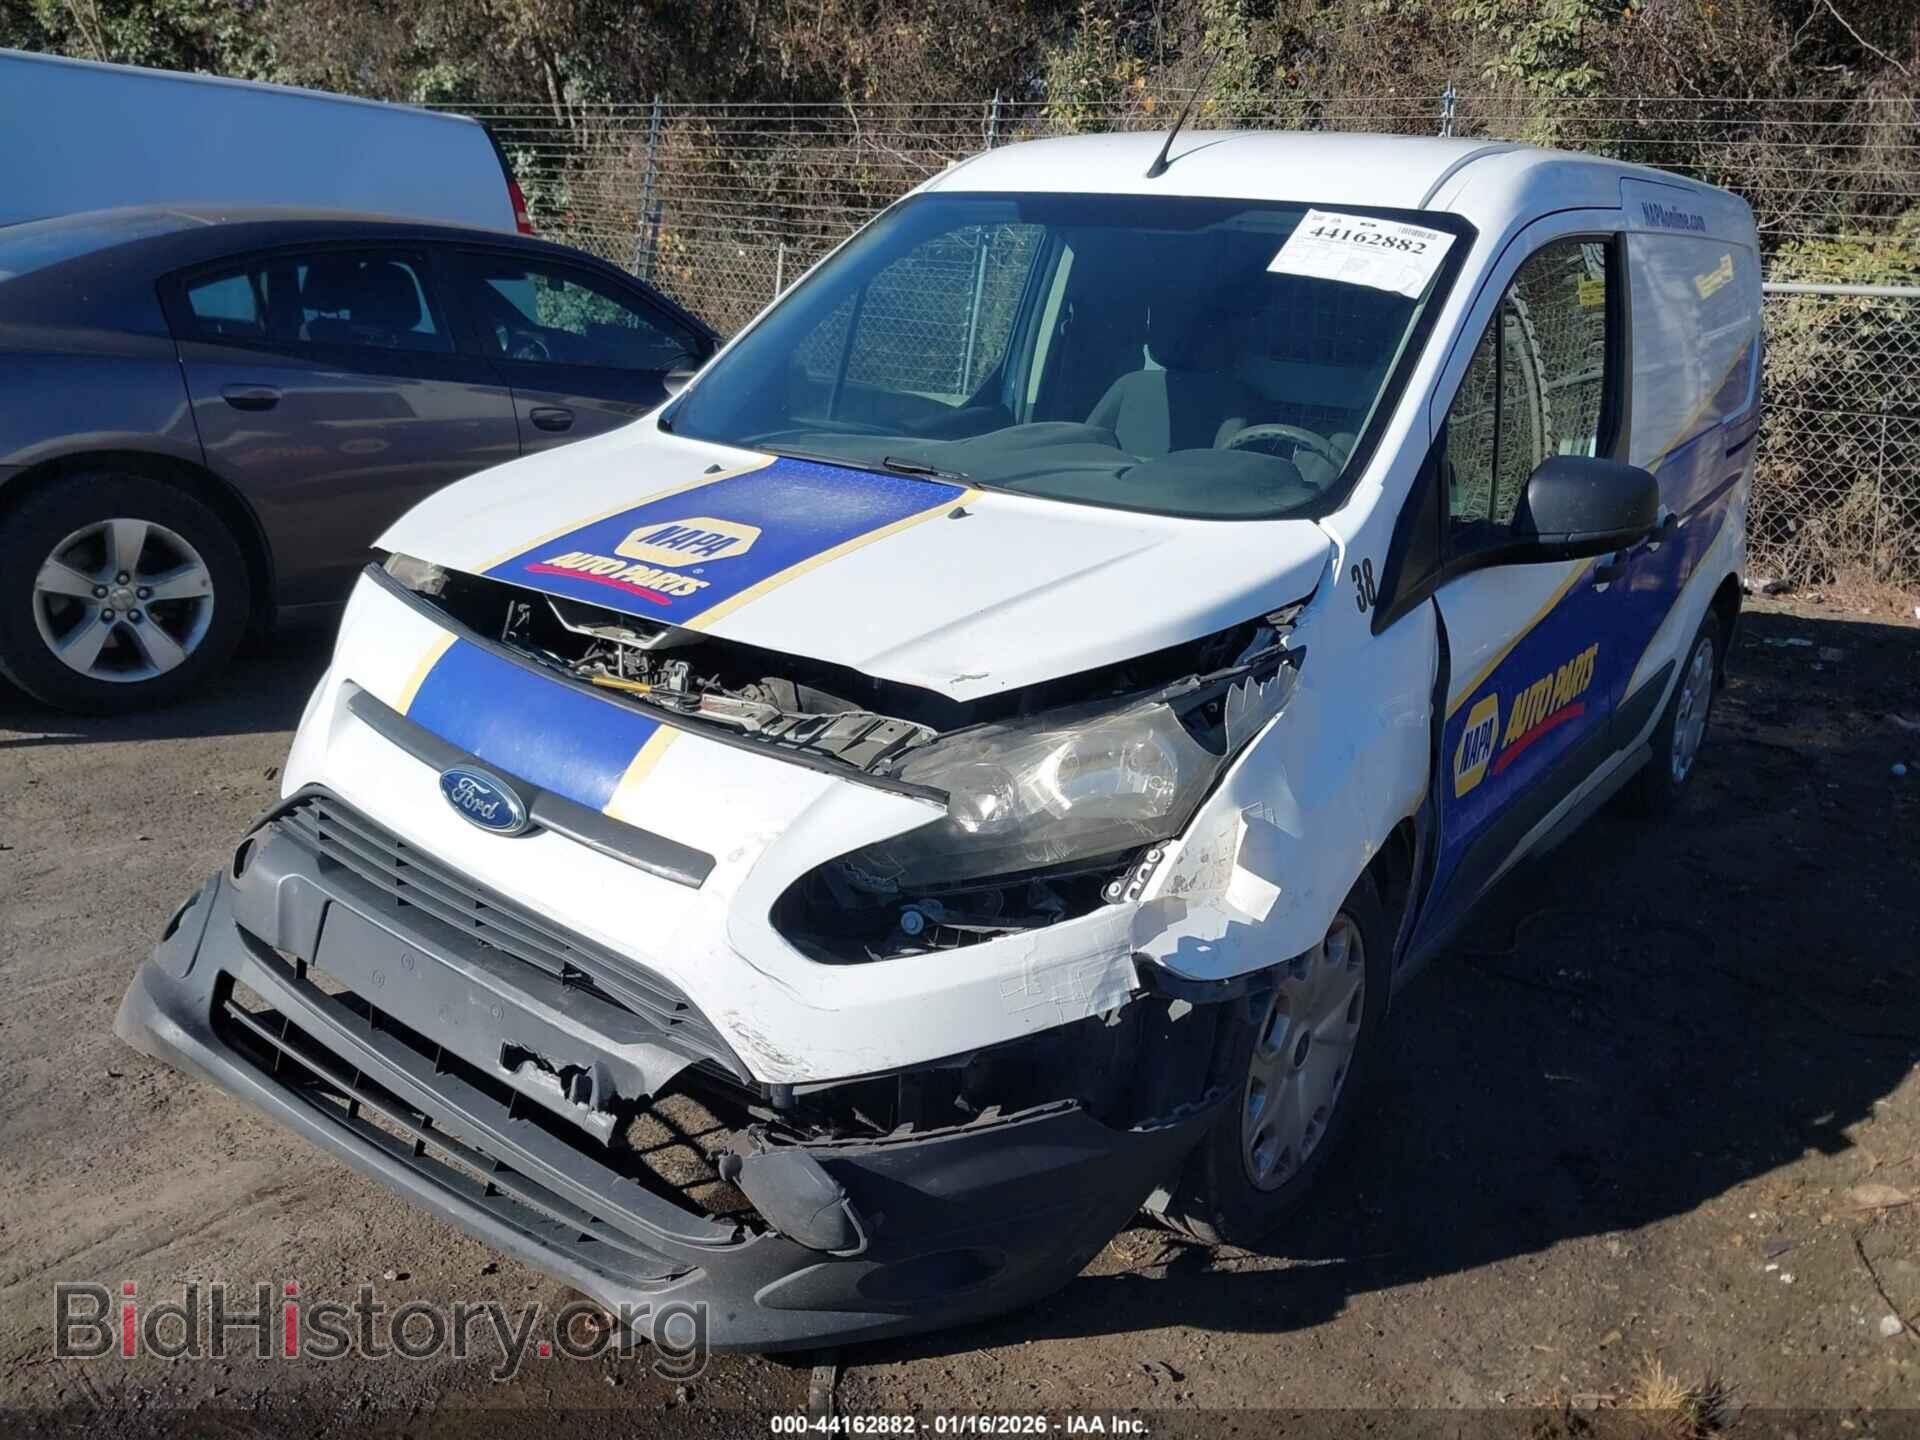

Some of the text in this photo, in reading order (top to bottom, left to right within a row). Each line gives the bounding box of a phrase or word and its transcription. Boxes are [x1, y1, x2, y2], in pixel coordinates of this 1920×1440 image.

[1309, 226, 1427, 255] 44162882
[637, 525, 741, 557] NAPA
[541, 551, 711, 596] AUTO PARTS
[1351, 557, 1376, 613] 38
[1501, 642, 1599, 750] AUTO PARTS
[1459, 716, 1494, 775] NAPA
[451, 777, 500, 819] Ford
